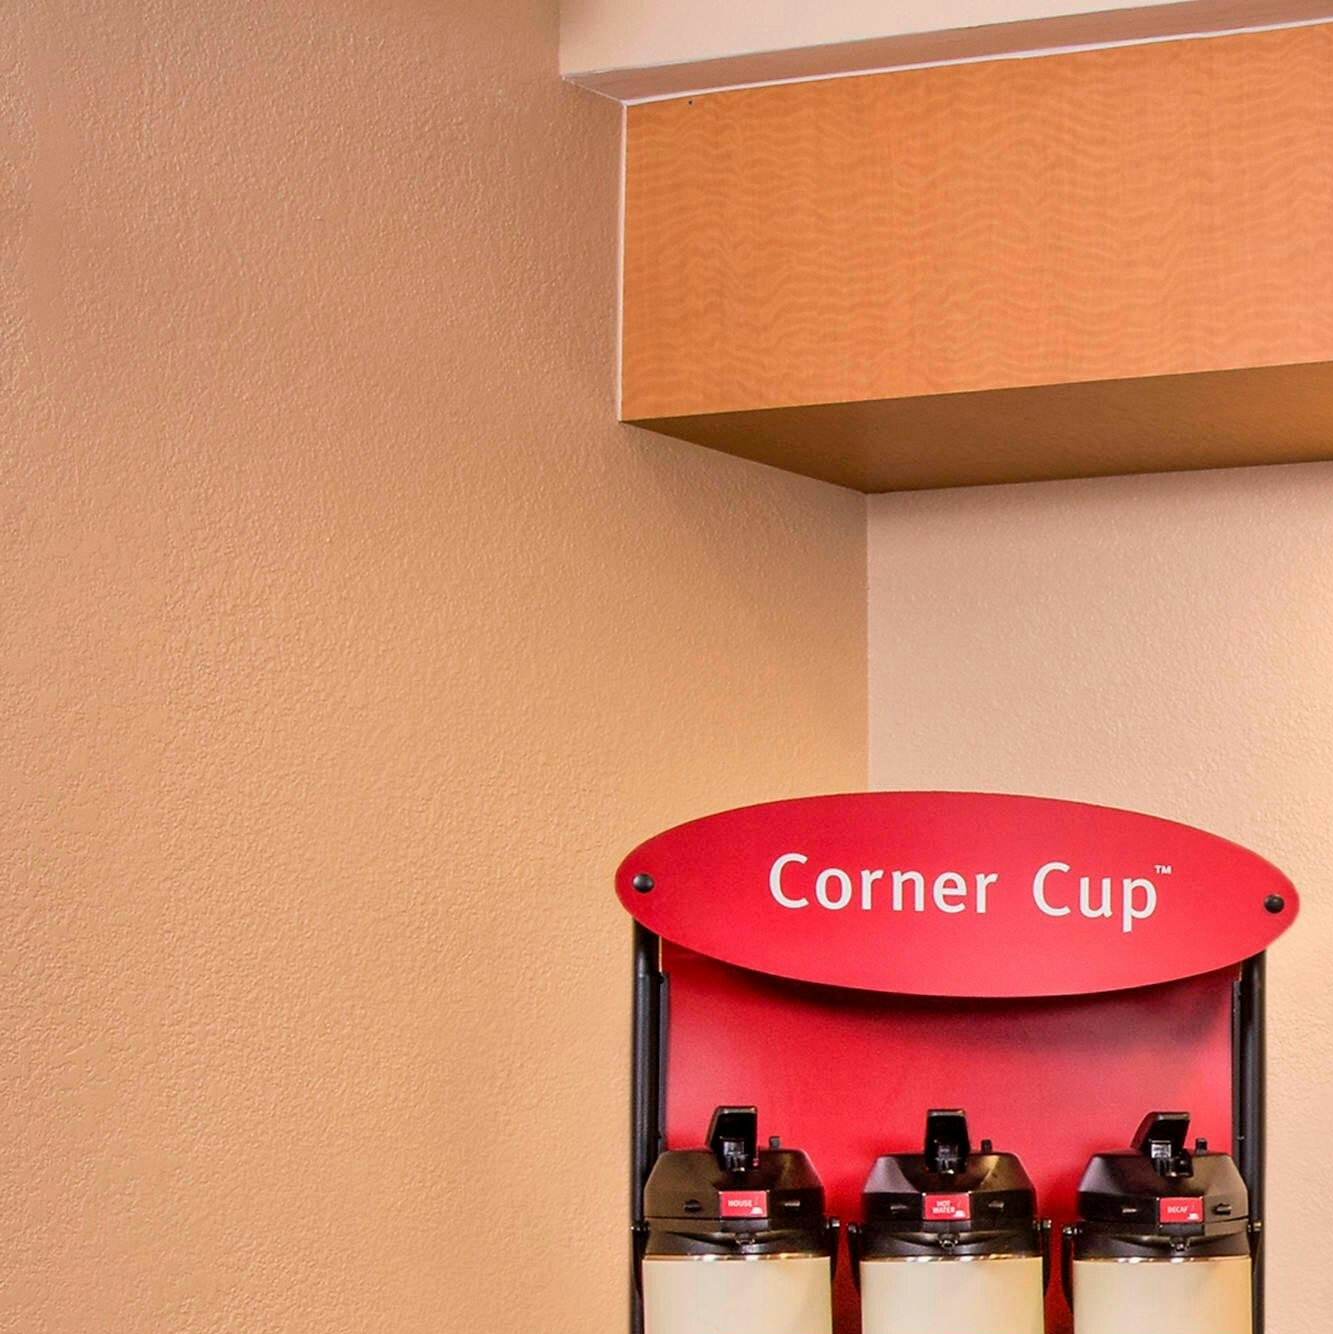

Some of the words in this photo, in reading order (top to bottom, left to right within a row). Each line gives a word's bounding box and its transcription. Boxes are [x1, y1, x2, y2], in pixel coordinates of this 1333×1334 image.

[769, 852, 998, 914] Corner
[727, 1199, 753, 1208] HOUSE
[1167, 1205, 1188, 1214] DECAF
